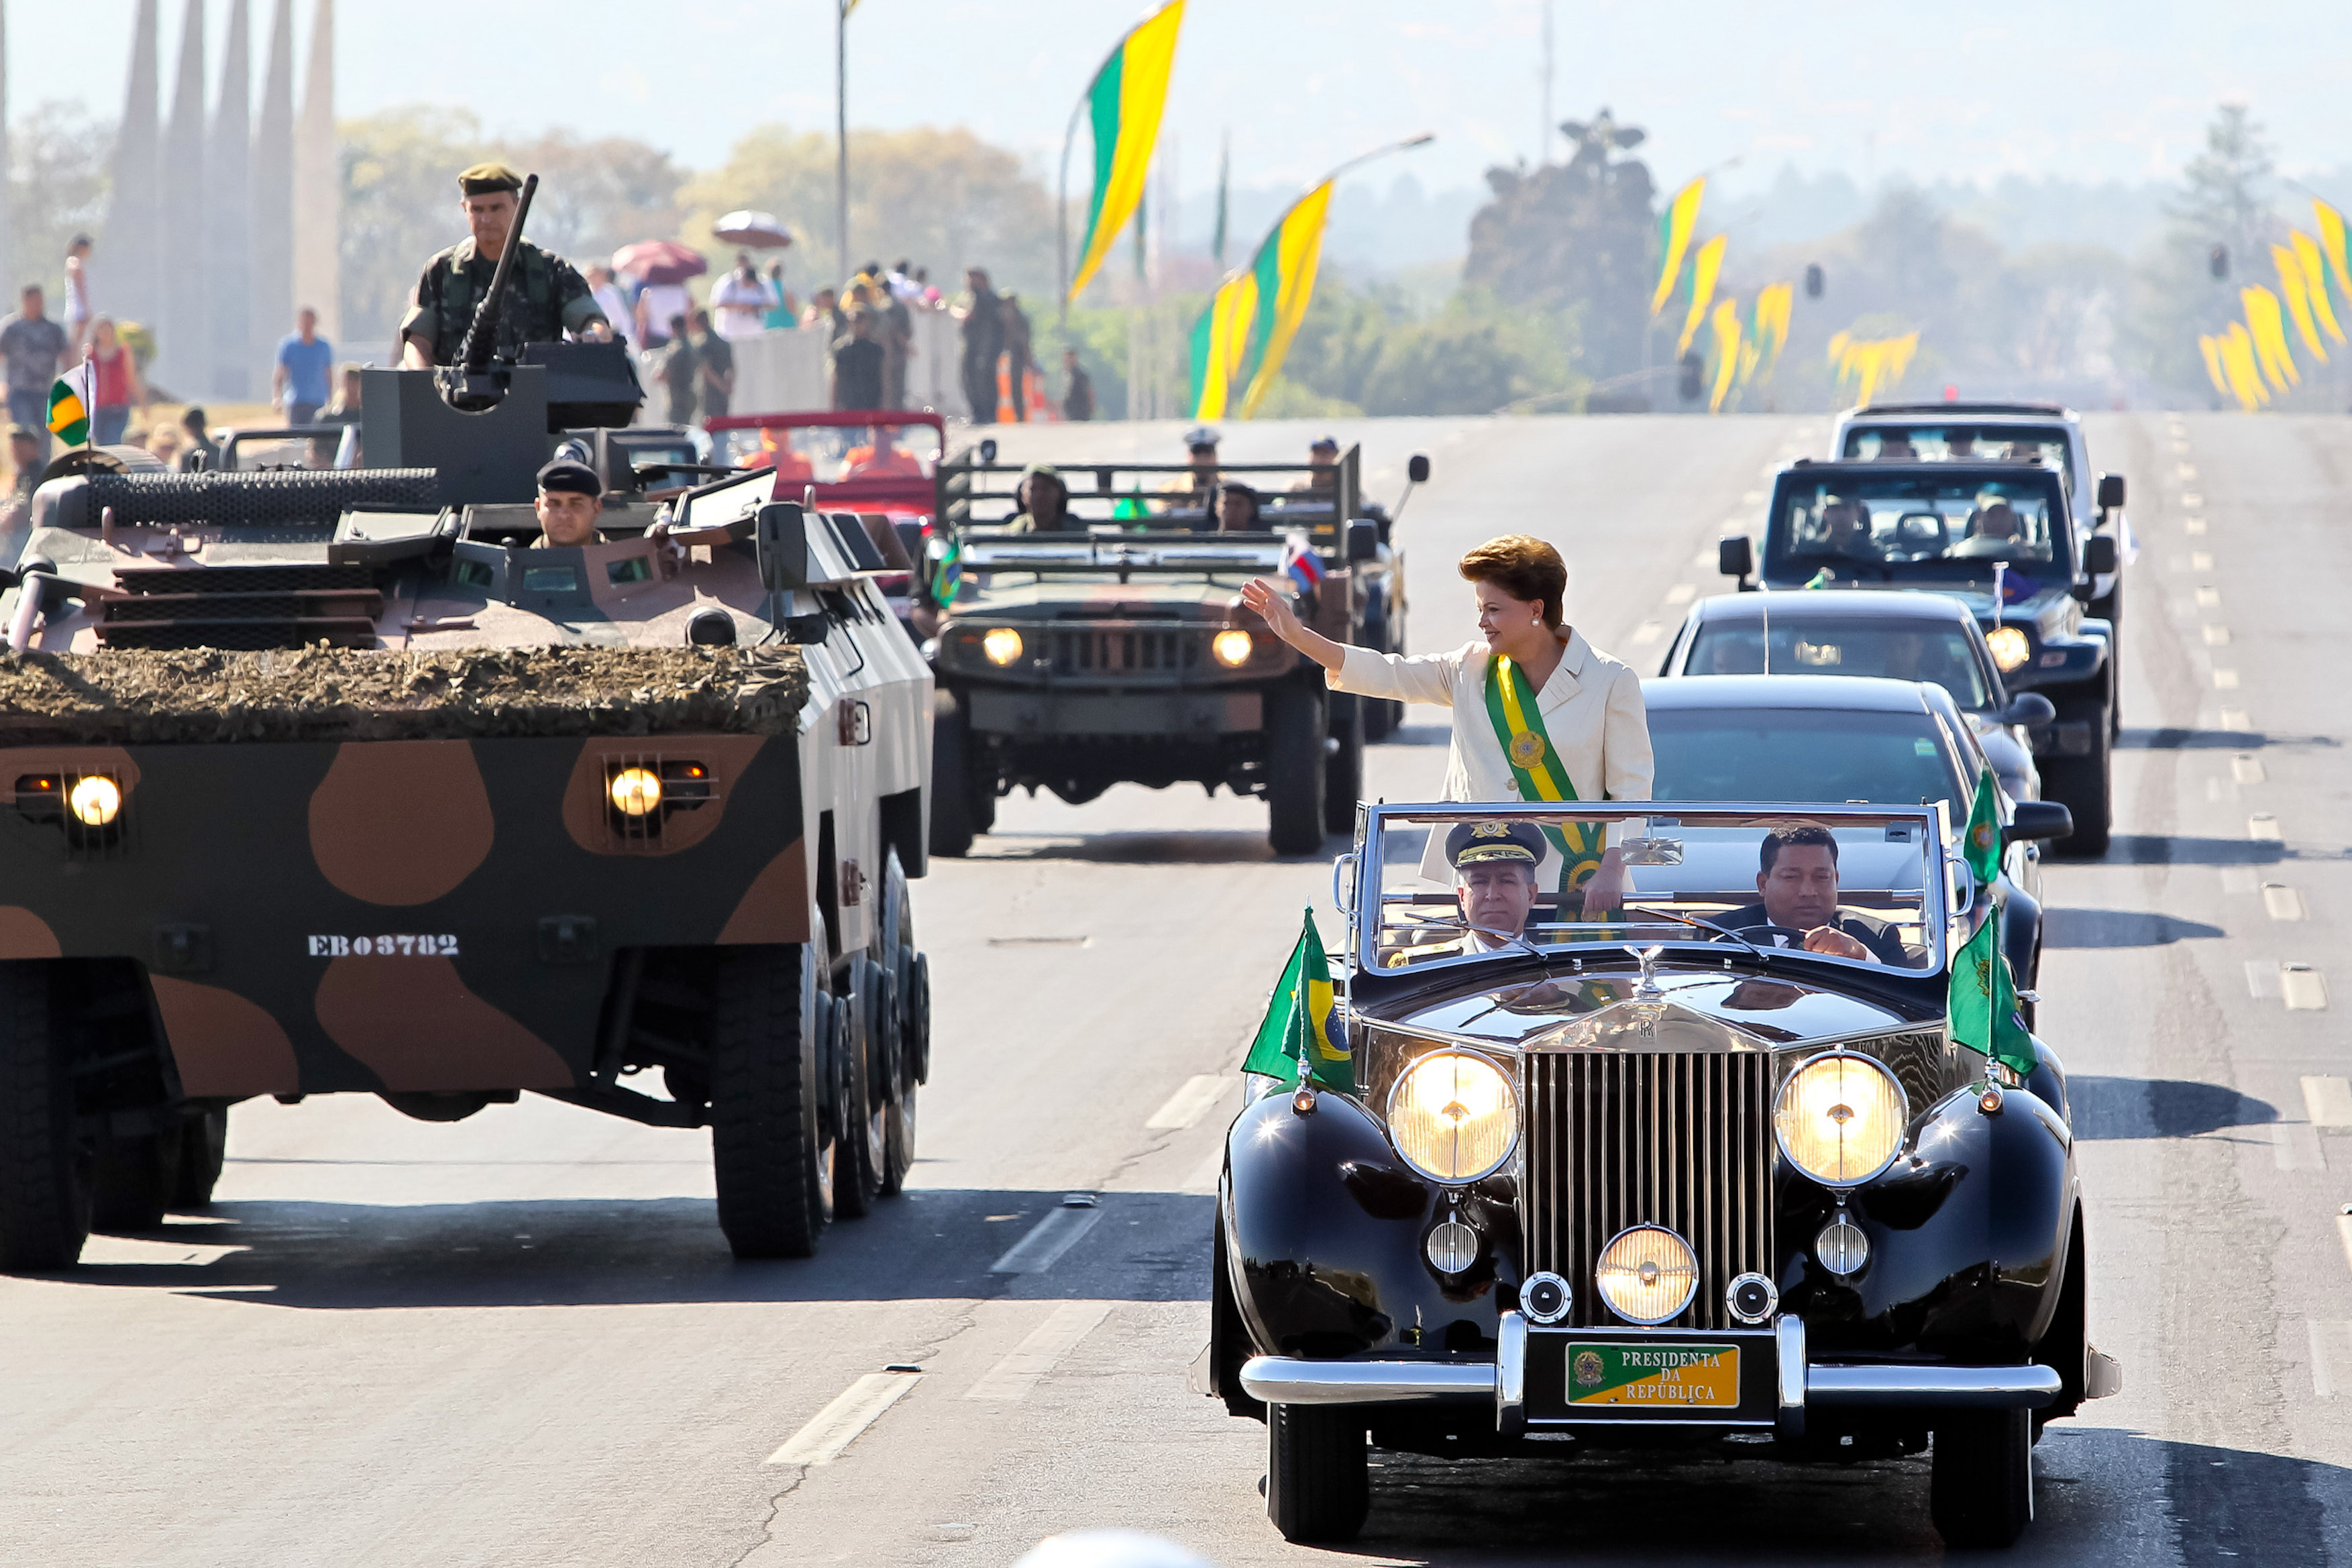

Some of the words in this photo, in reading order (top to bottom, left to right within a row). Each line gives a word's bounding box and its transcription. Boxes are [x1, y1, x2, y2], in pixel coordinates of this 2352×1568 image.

[1621, 1351, 1720, 1367] PRESIDENTA
[1660, 1367, 1681, 1382] DA
[1626, 1382, 1715, 1400] REPÚBLICA
